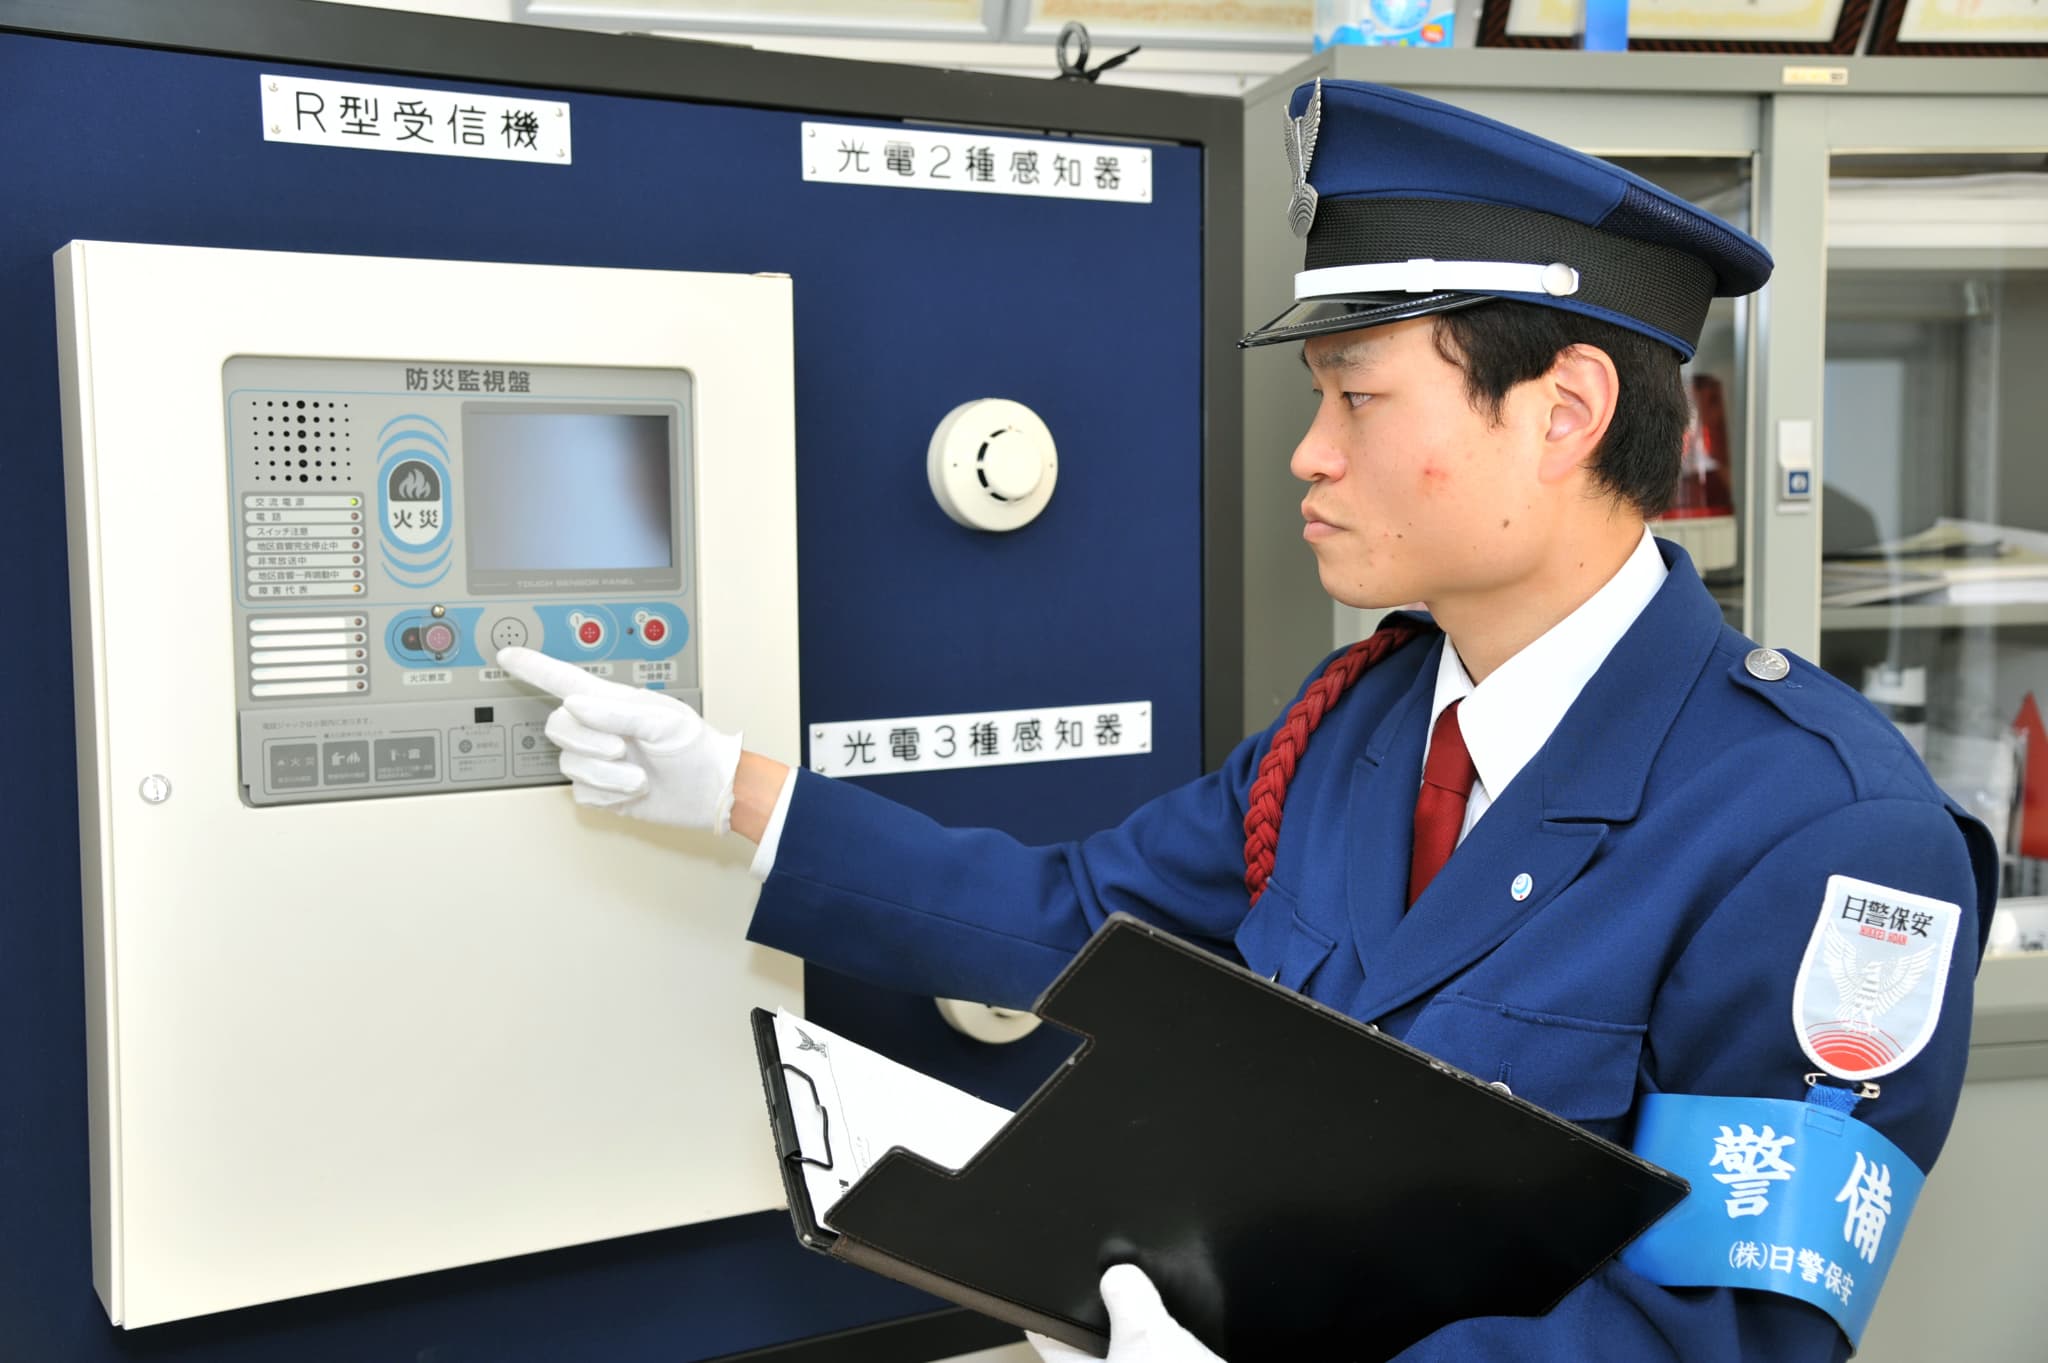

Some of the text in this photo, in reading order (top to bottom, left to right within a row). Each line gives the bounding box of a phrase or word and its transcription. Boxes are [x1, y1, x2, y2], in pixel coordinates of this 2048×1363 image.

[295, 91, 539, 151] R型受信機
[837, 137, 1122, 191] 光電2種感知器
[405, 367, 531, 393] 防災監視盤
[393, 508, 439, 530] 火災
[843, 714, 1122, 768] 光電3種感知器
[1842, 895, 1934, 938] 日警保安
[1709, 1124, 1893, 1265] 警備
[1728, 1240, 1855, 1307] (株)日警保安
